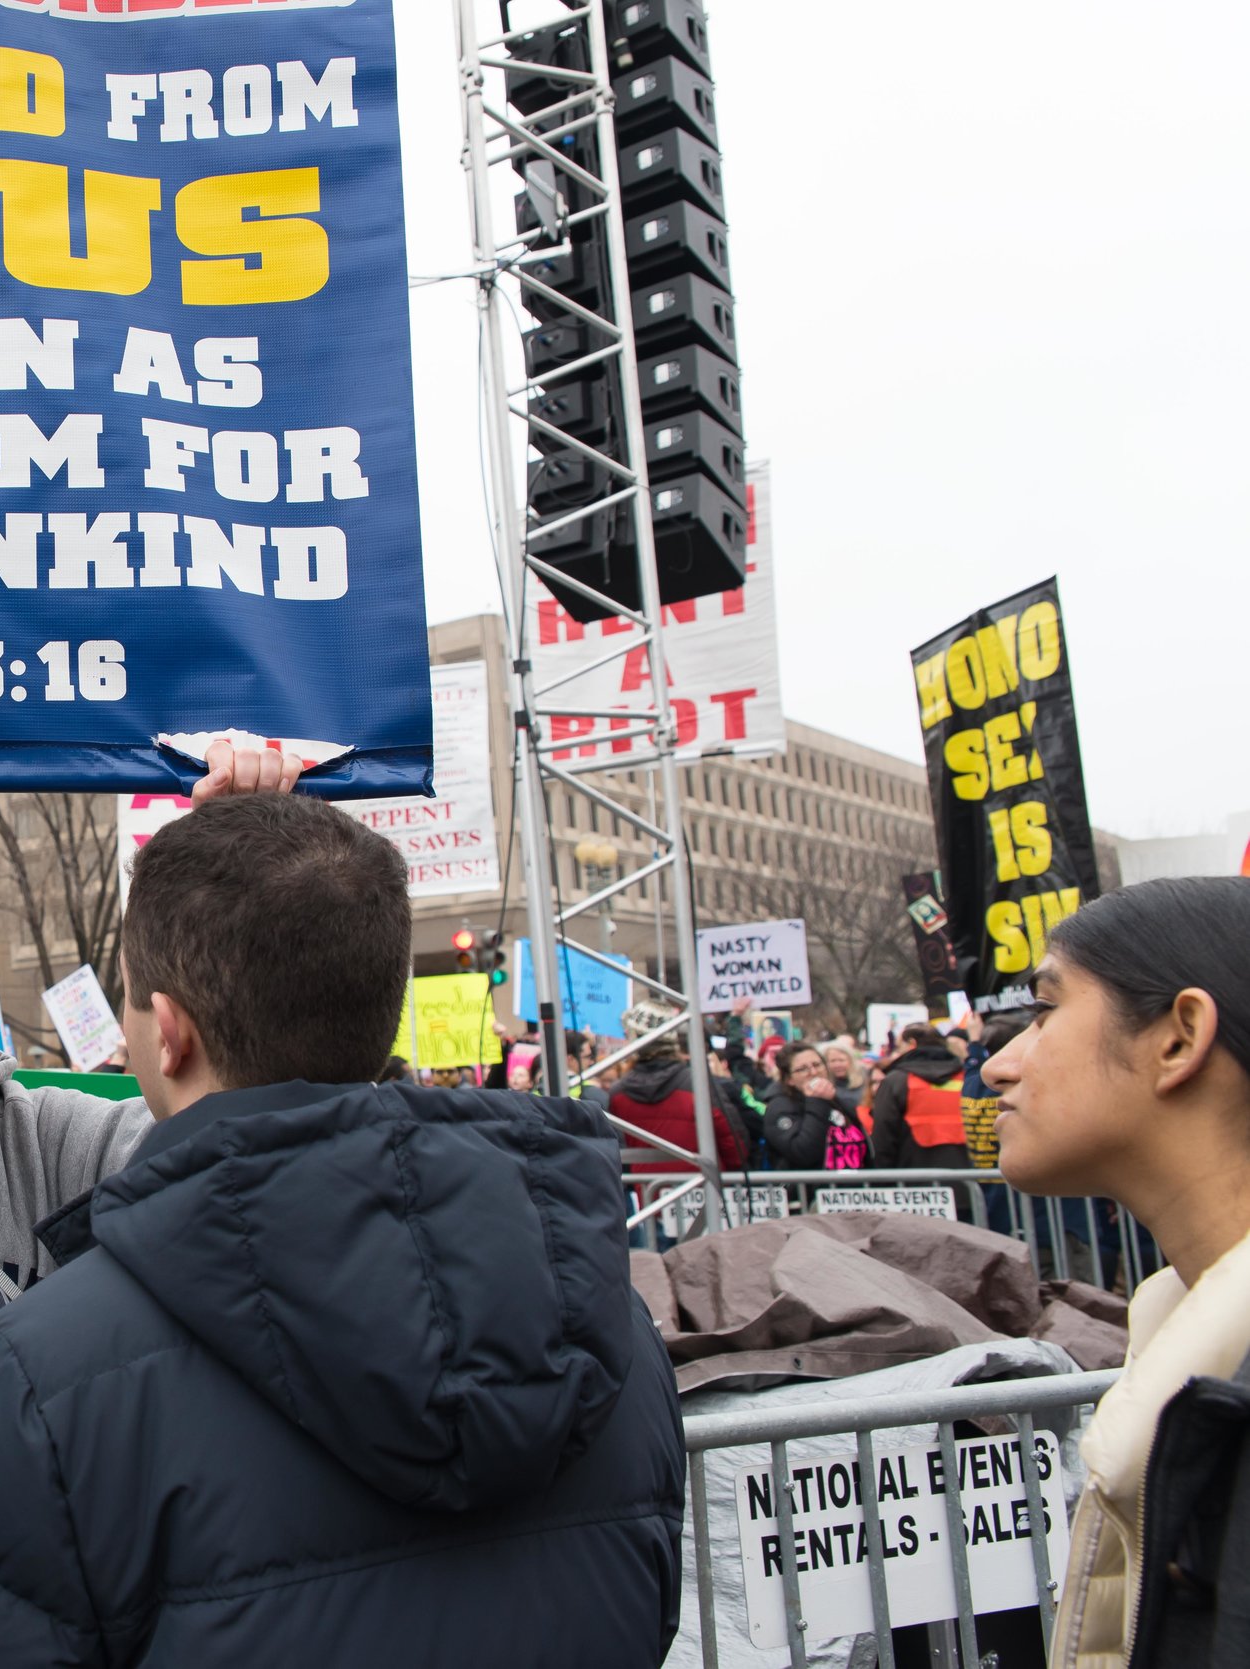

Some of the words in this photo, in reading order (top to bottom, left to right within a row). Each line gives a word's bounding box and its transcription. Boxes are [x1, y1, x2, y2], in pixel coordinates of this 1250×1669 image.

[105, 56, 359, 143] FROM
[113, 326, 263, 408] AS
[141, 417, 370, 504] FOR
[549, 688, 758, 762] RIOT
[407, 828, 482, 854] SAVES
[988, 800, 1052, 884] IS
[711, 935, 771, 957] NASTY
[712, 957, 782, 977] WOMAN
[708, 976, 803, 1001] ACTIVATED
[821, 1190, 890, 1205] NATIONAL
[893, 1190, 950, 1205] EVENTS
